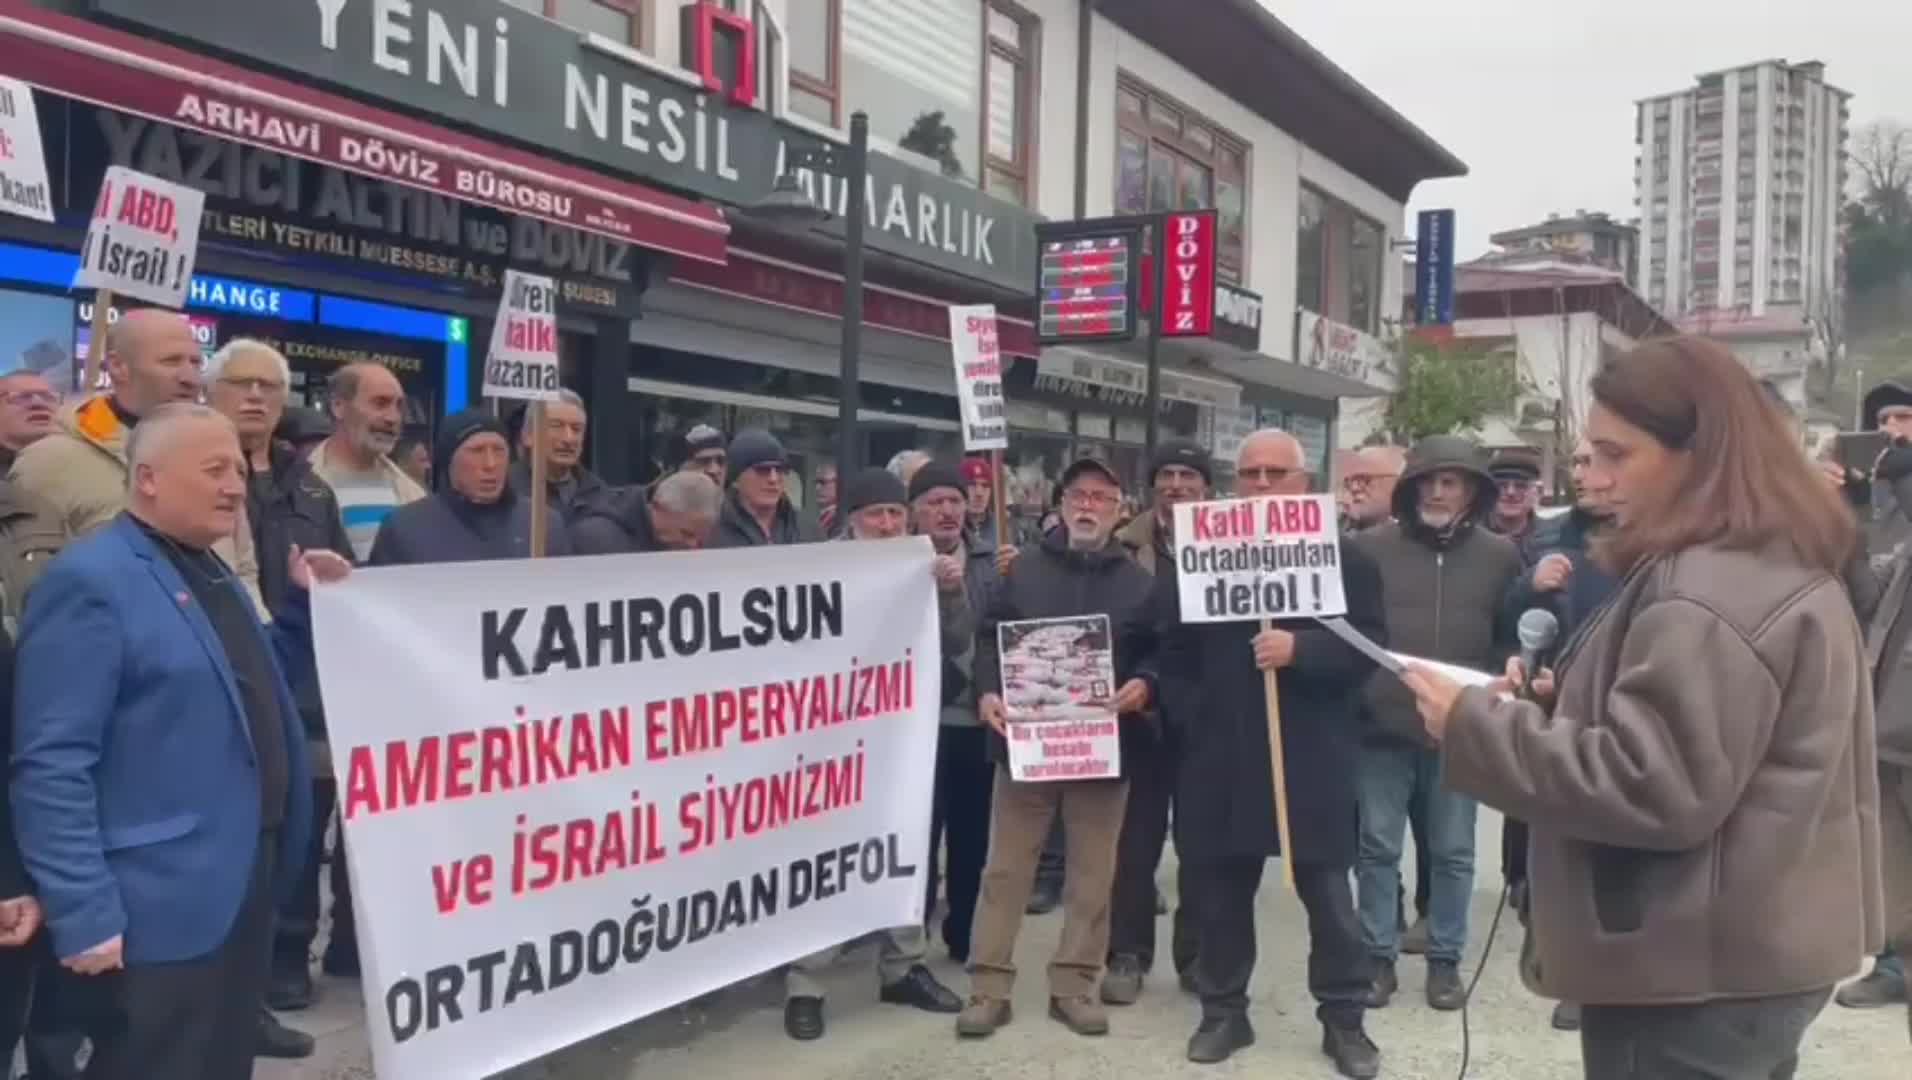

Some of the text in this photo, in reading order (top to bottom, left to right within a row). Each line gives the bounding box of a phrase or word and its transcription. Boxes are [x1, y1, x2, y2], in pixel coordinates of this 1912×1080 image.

[314, 0, 509, 108] YENİ
[563, 62, 740, 182] NESİL
[175, 93, 573, 218] ARHAVİ DÖVİZ BÜROSU
[97, 224, 169, 287] İsrail
[117, 184, 179, 244] ABD,
[190, 278, 281, 313] HANGE
[1175, 215, 1200, 331] DÖVİZ
[1181, 538, 1337, 575] Ortadoğudan
[1191, 499, 1321, 541] Katil ABD
[480, 580, 843, 681] KAHROLSUN
[1204, 572, 1323, 617] defol !
[344, 647, 914, 820] AMERİKAN EMPERYALİZMİ
[431, 740, 865, 914] ve İSRAİL SİYONİZMİ
[384, 833, 917, 1044] ORTADOĞUDAN DEFOL
